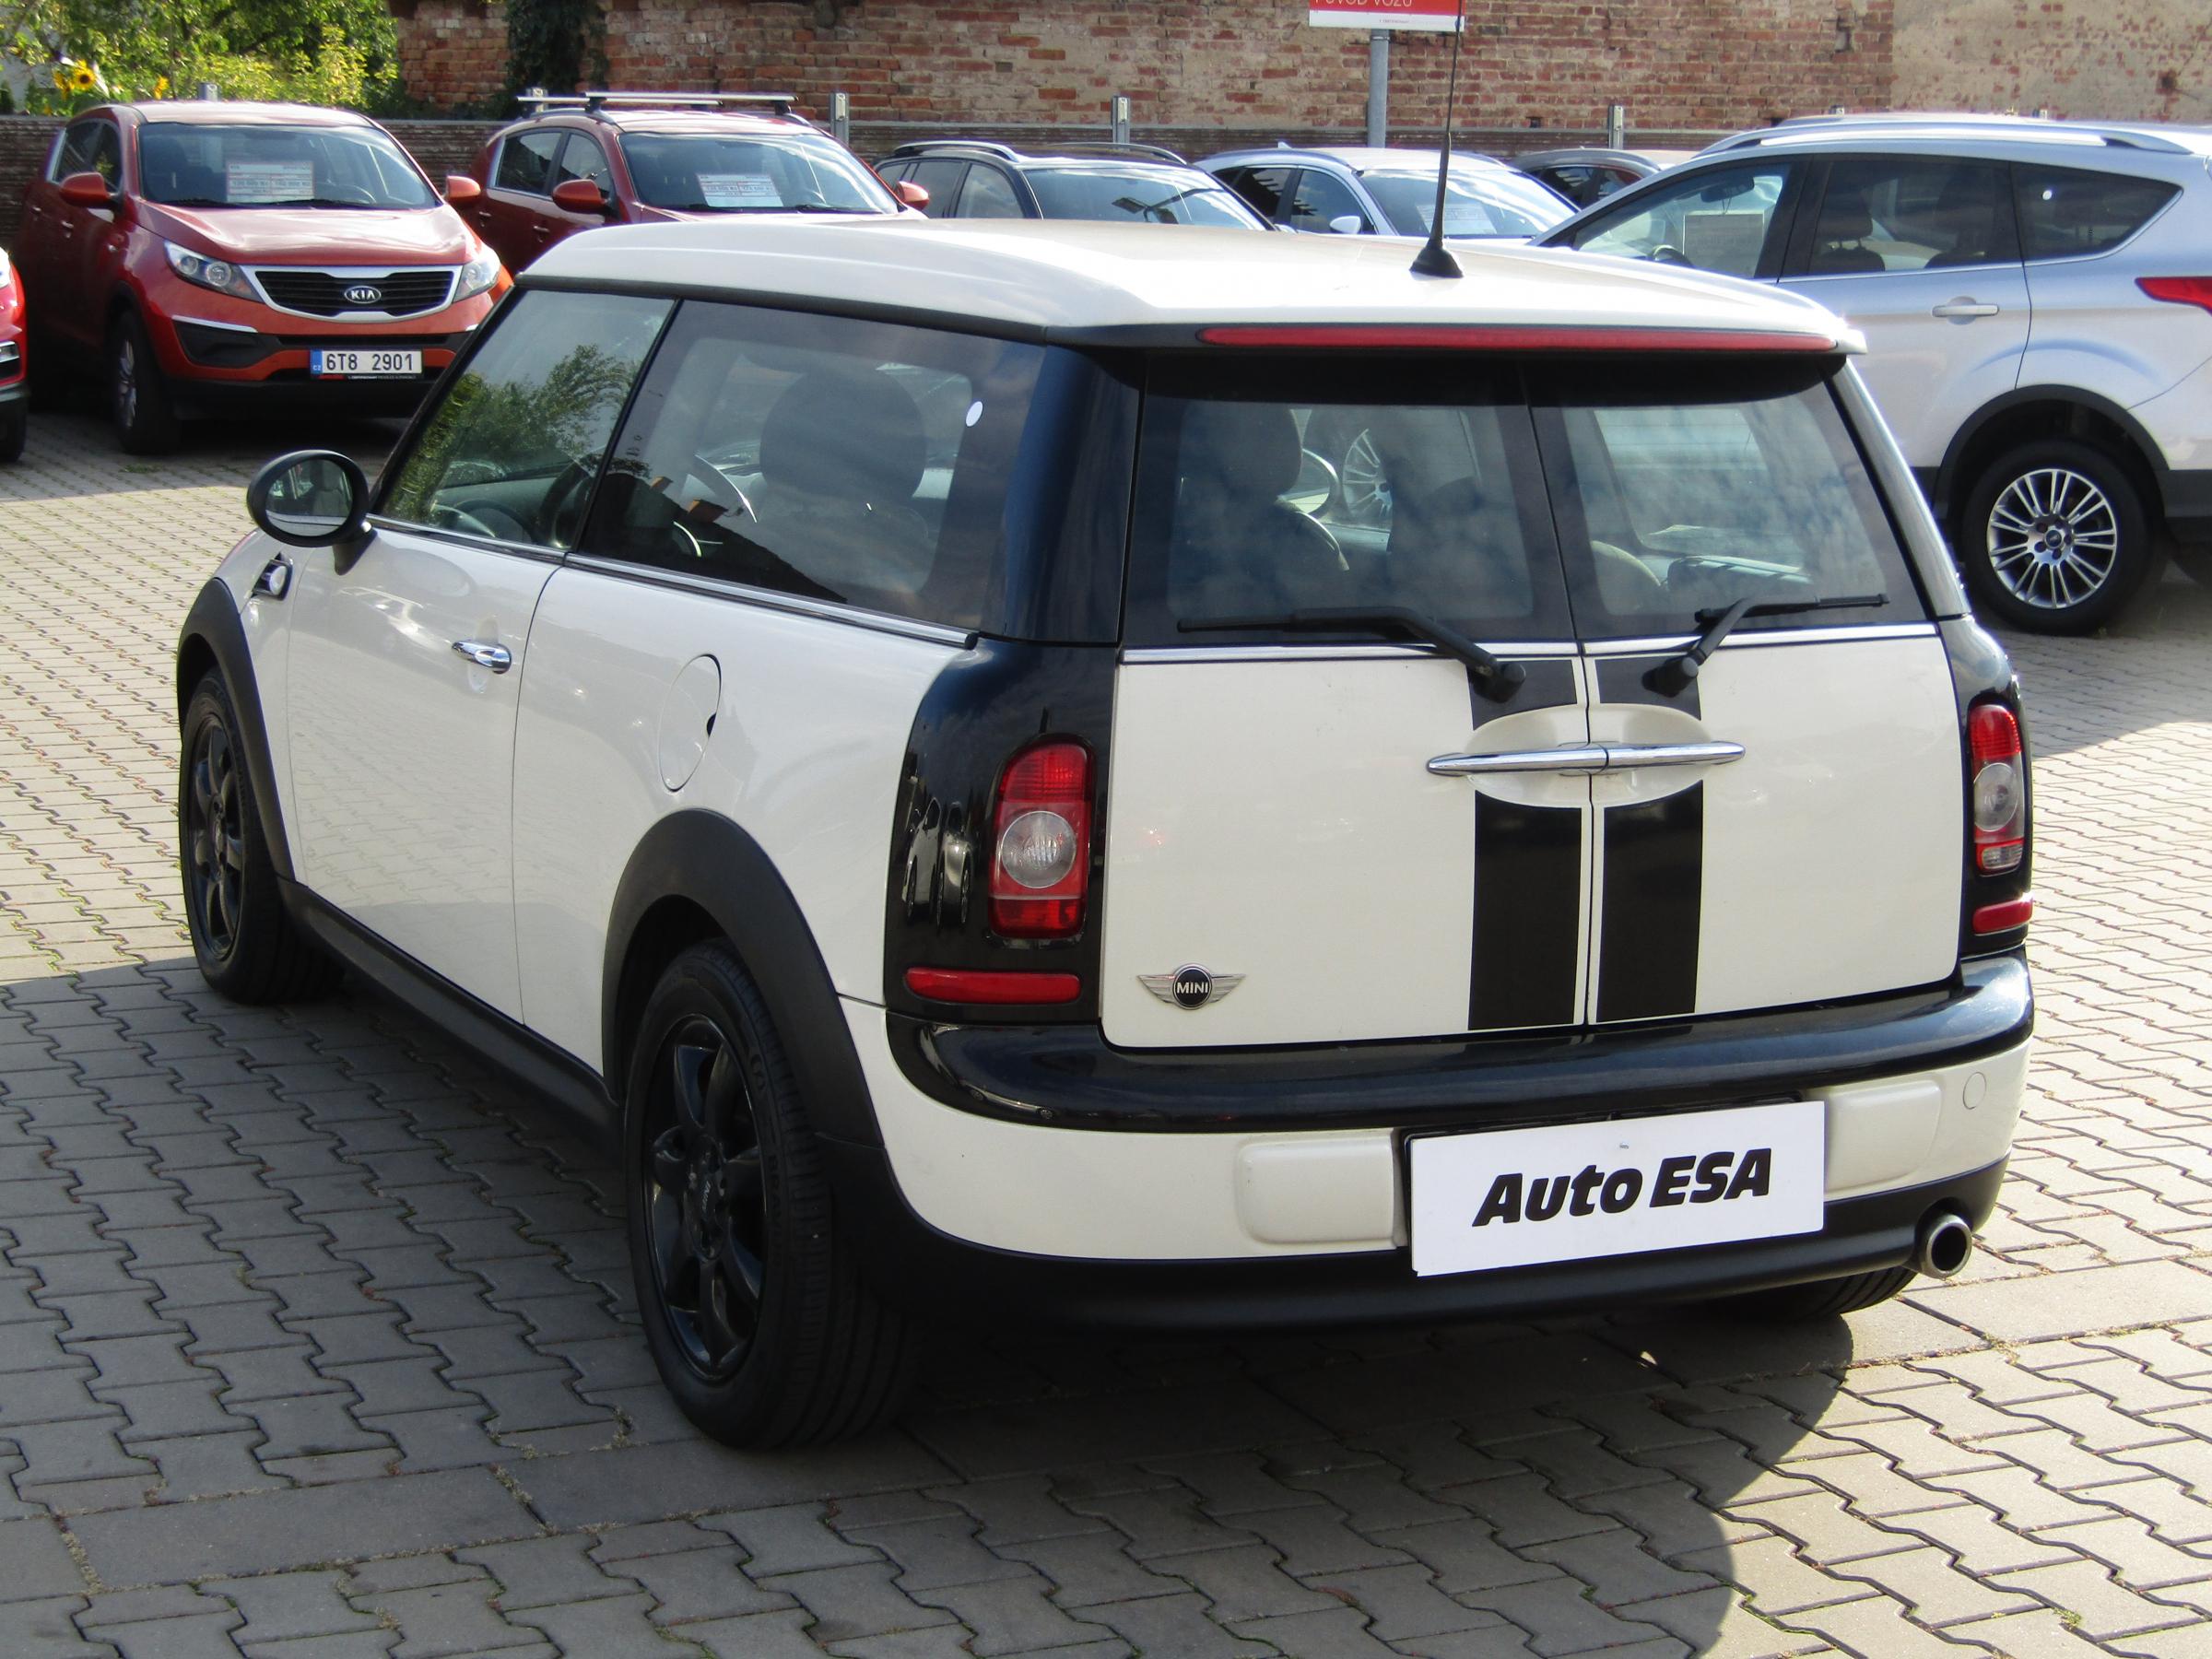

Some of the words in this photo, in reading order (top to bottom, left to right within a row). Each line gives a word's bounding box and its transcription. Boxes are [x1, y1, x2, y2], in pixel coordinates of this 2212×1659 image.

[350, 289, 376, 300] KIA
[326, 353, 358, 371] 6T8
[371, 353, 413, 371] 2901
[1176, 982, 1208, 994] MINI
[1472, 1165, 1643, 1228] Auto
[1649, 1147, 1772, 1208] ESA
